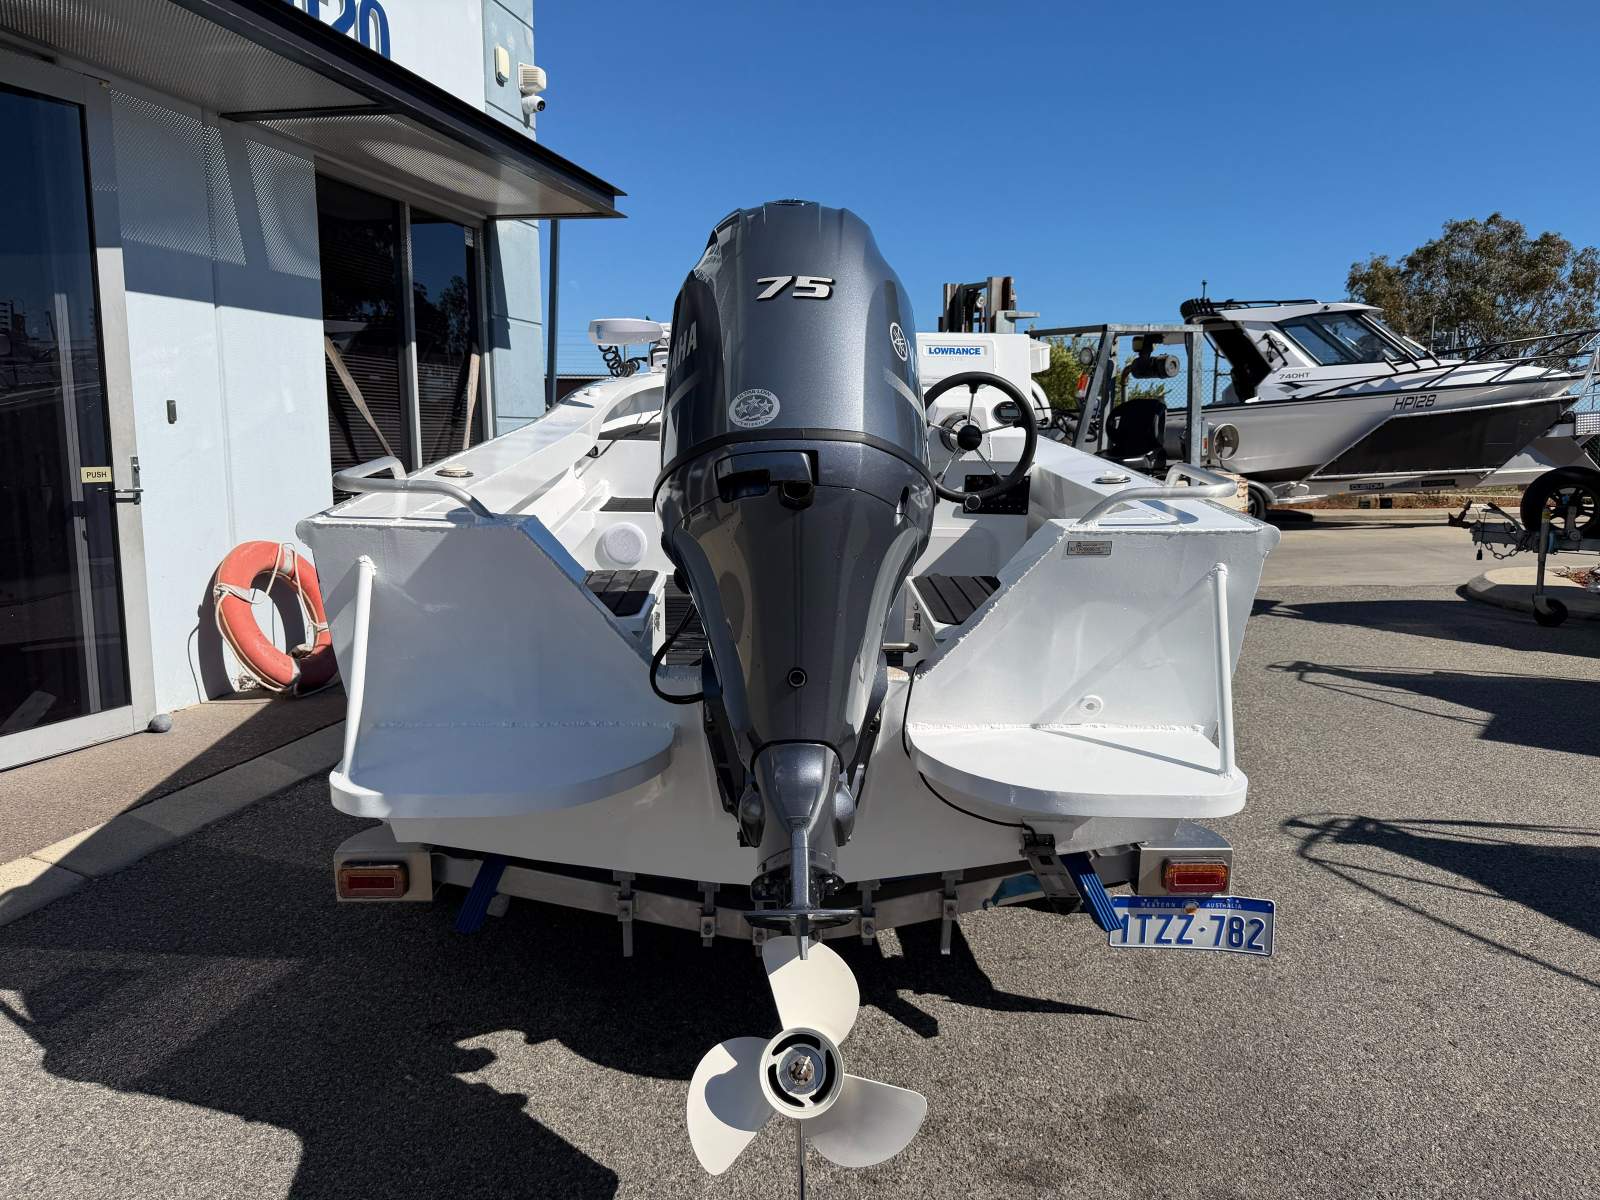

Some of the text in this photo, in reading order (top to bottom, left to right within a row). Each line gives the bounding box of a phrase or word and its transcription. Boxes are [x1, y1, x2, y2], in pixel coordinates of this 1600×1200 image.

[756, 275, 834, 300] 75
[928, 347, 981, 356] LOWRANCE
[1393, 394, 1437, 410] HP128
[86, 471, 107, 479] PUSH
